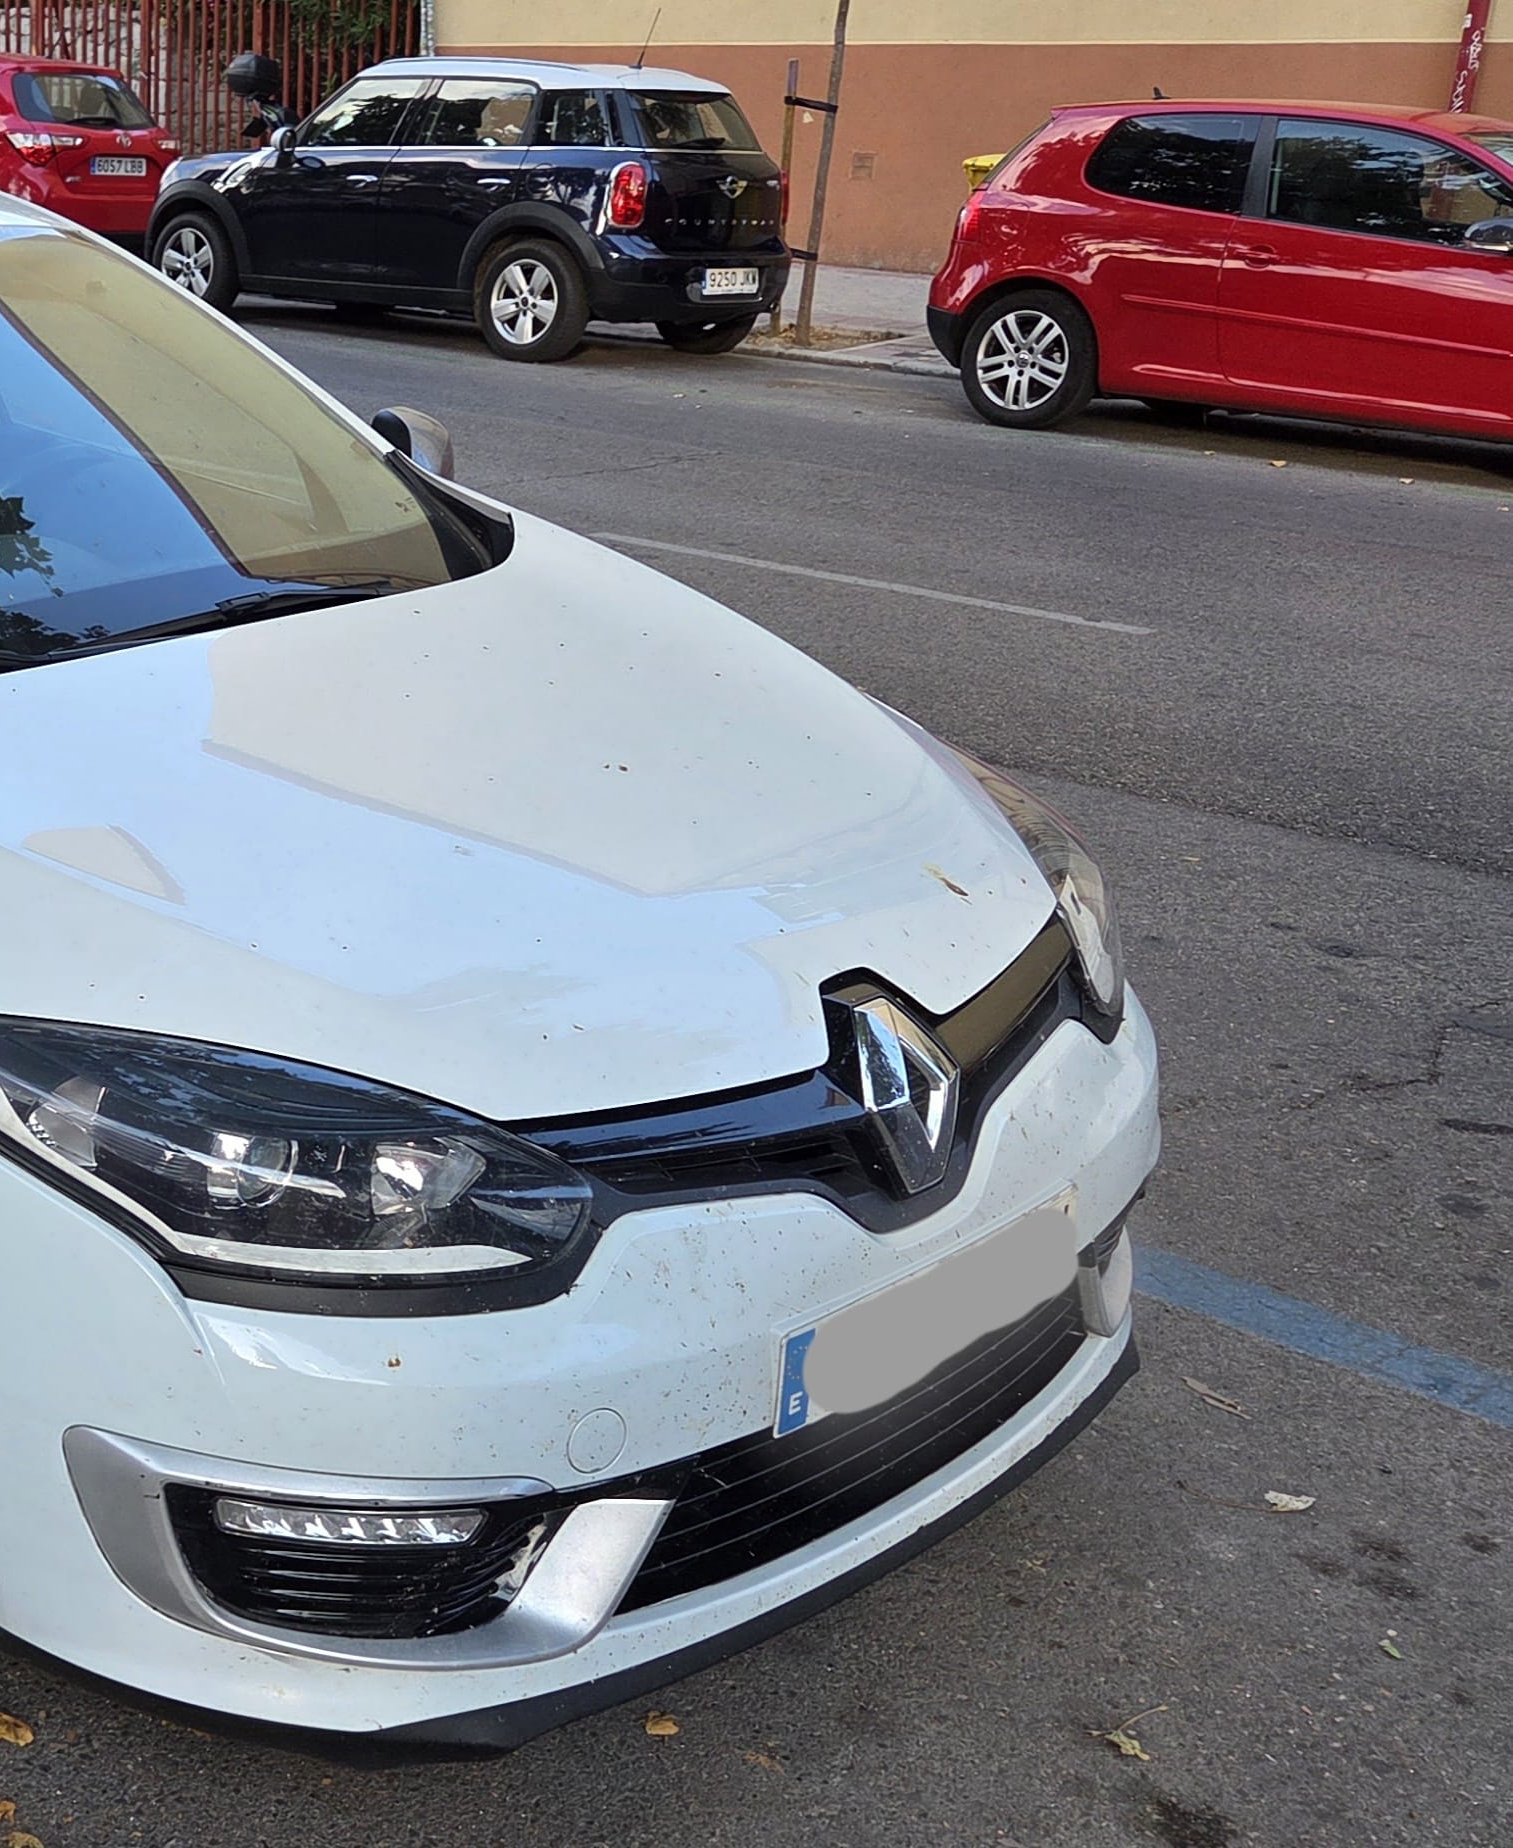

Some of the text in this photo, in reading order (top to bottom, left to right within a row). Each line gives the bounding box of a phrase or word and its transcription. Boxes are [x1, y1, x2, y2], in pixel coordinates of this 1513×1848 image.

[97, 159, 123, 173] 6057
[709, 271, 737, 288] 9250
[788, 1390, 804, 1416] E
